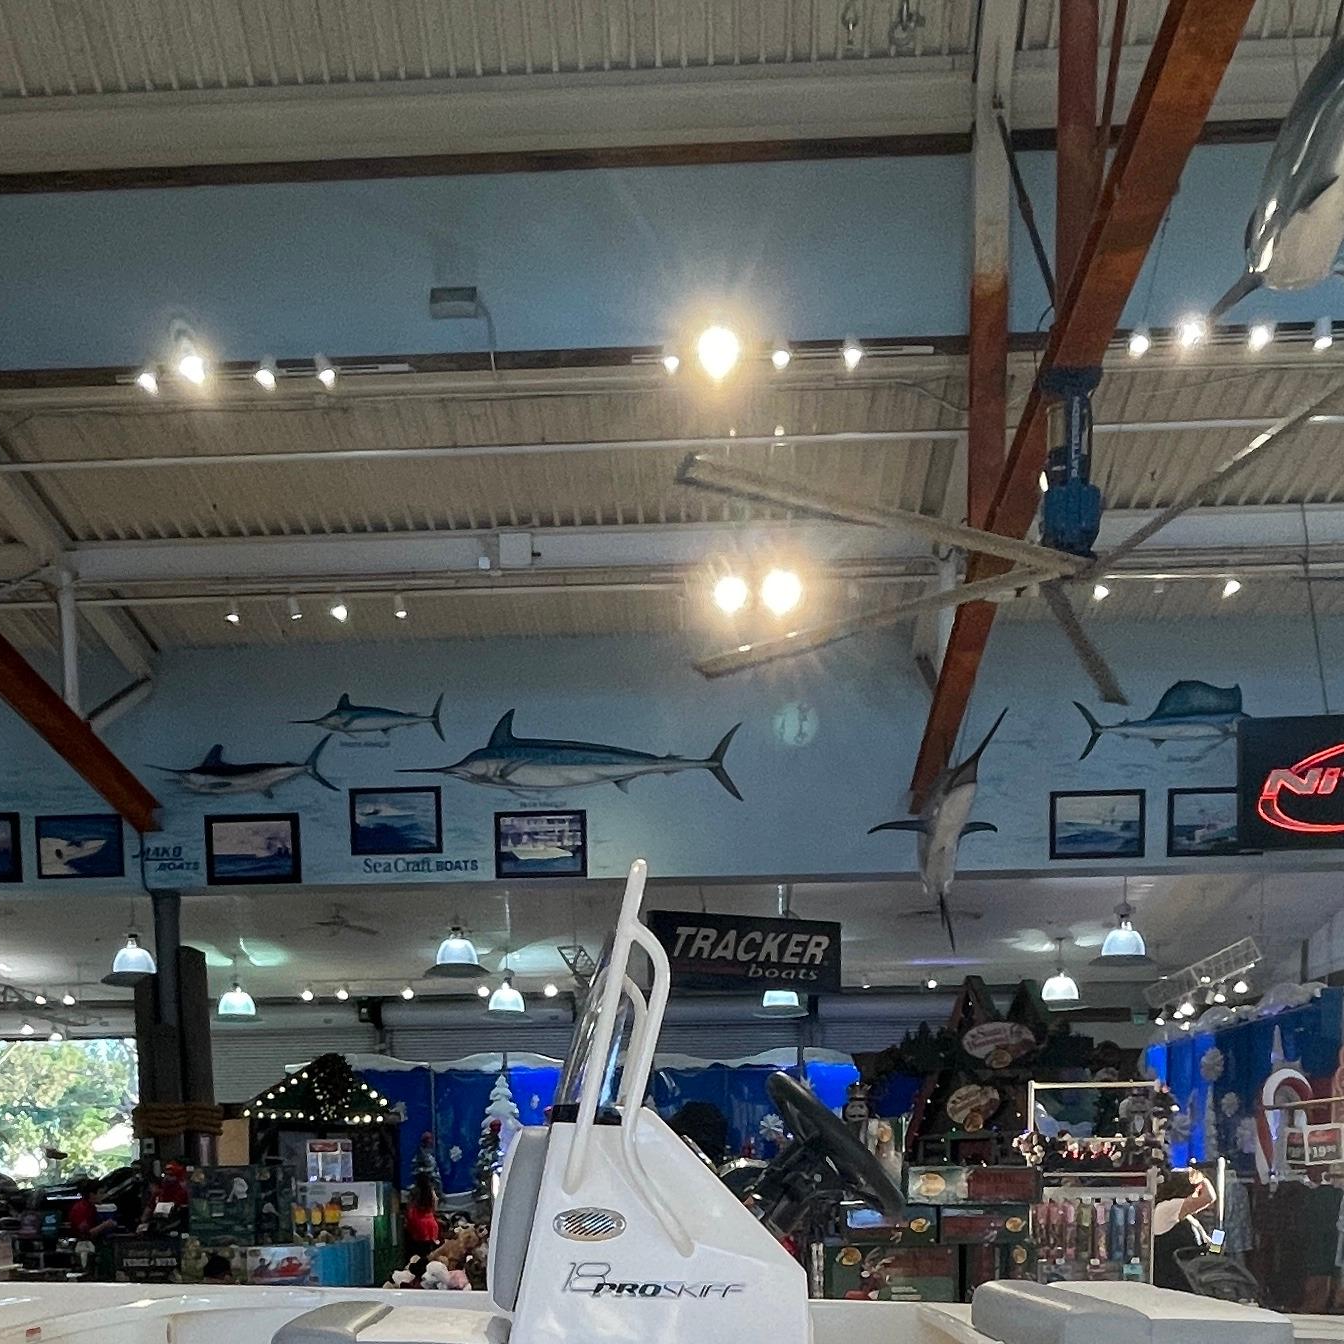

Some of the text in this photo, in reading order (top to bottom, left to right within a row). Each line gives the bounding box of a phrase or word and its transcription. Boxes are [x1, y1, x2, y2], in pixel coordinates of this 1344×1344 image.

[436, 860, 479, 871] BOATS
[673, 926, 831, 965] TRACKER
[748, 964, 818, 981] boats
